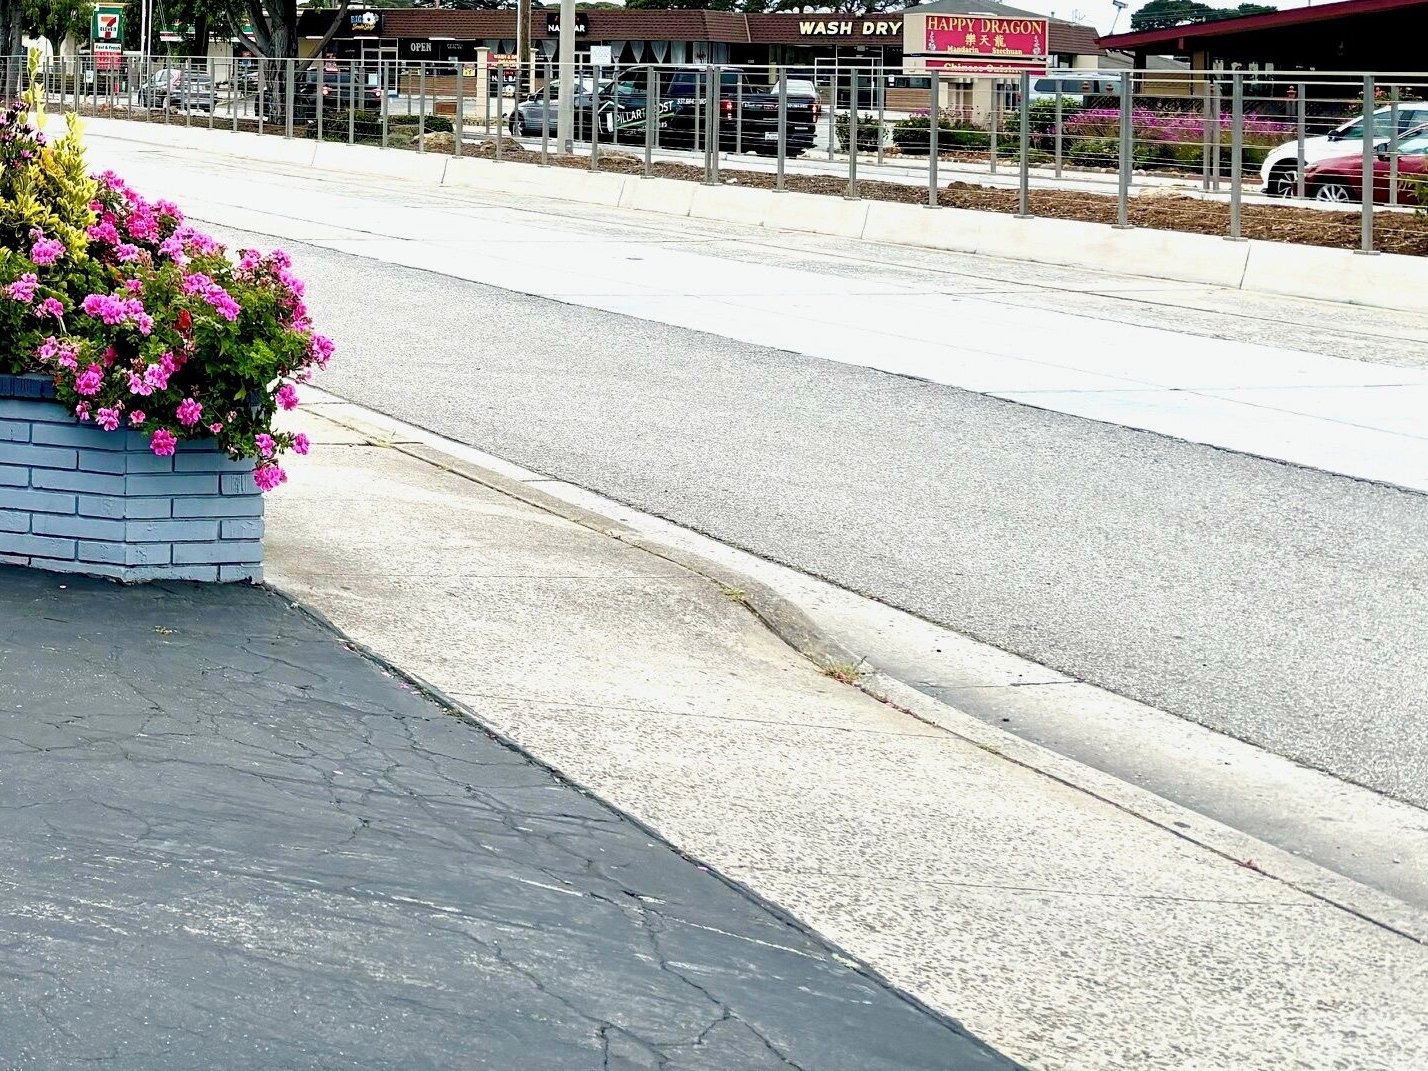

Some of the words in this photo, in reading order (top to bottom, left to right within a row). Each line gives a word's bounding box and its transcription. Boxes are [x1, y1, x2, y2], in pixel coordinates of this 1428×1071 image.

[350, 15, 363, 24] BIG
[573, 24, 586, 32] AR
[799, 21, 853, 35] WASH
[862, 21, 903, 35] DRY
[928, 16, 976, 32] HAPPY
[981, 19, 1043, 35] DRAGON
[410, 42, 432, 52] OPEN
[947, 45, 980, 53] Mandarin
[992, 47, 1023, 55] Szechuan
[944, 62, 984, 73] Chinese
